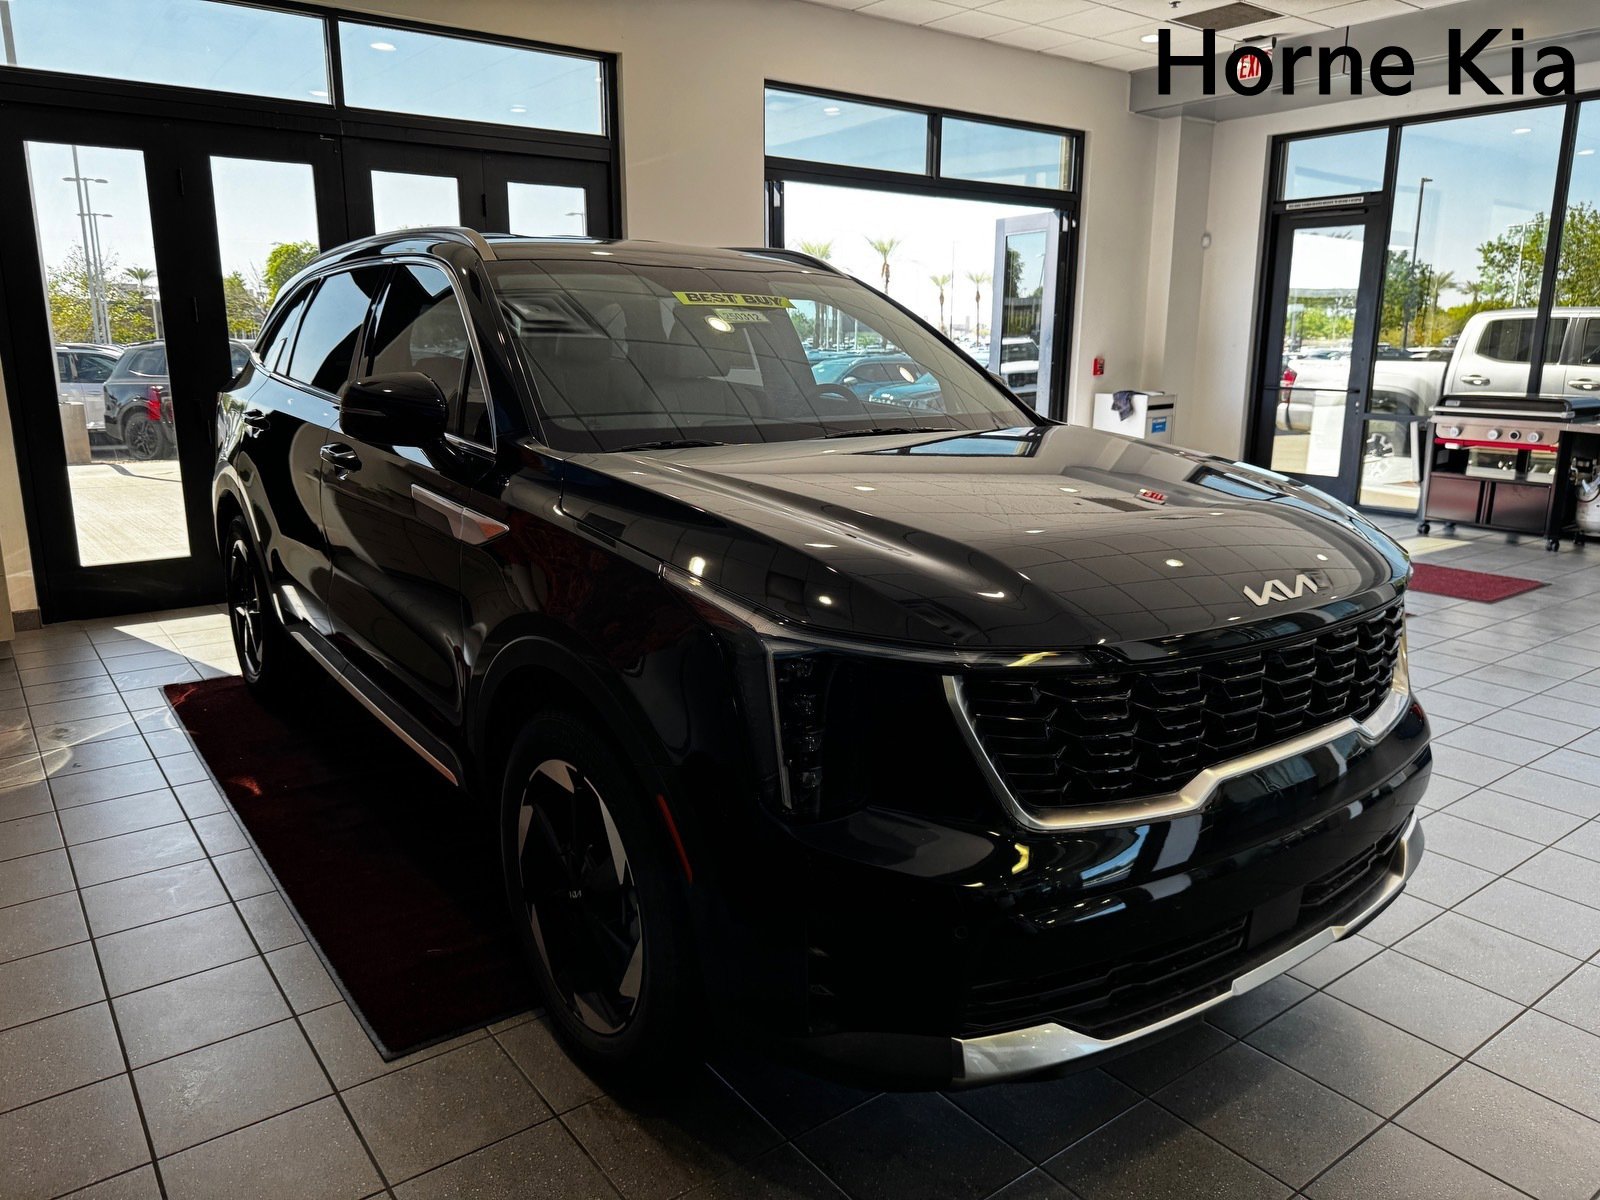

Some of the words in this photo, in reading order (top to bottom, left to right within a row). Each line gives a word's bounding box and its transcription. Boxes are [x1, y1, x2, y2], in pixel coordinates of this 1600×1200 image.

[1239, 49, 1272, 79] EXI
[685, 293, 738, 304] BEST
[741, 295, 783, 306] BUY
[1243, 574, 1318, 606] KIA
